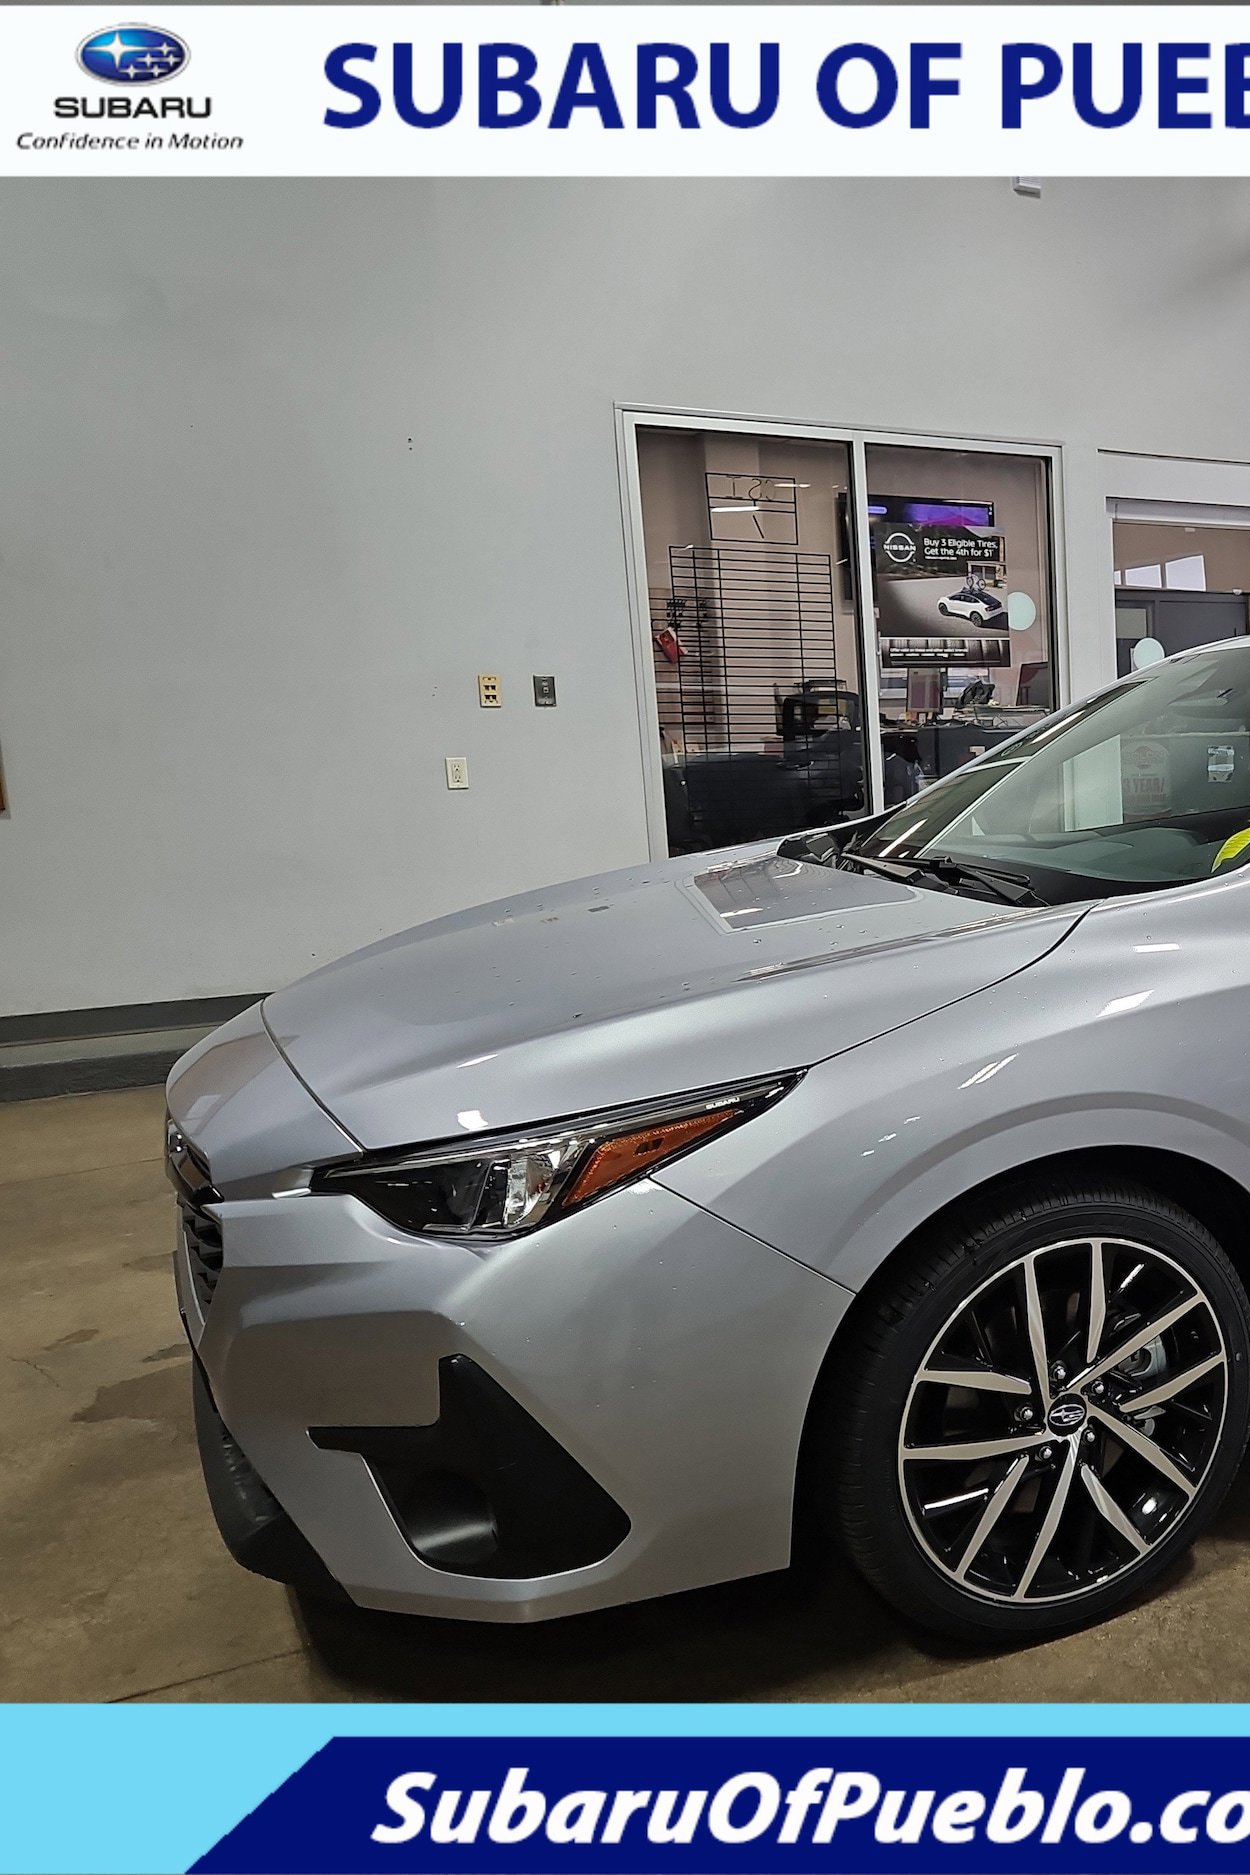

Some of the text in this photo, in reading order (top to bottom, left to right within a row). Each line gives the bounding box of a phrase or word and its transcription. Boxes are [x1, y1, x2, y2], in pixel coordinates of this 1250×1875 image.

[923, 538, 939, 548] Buy
[941, 539, 947, 547] 3
[948, 539, 975, 549] Eligible
[924, 547, 938, 555] Get
[940, 547, 954, 556] the
[956, 548, 969, 557] 4th
[706, 1097, 740, 1110] SUBARU
